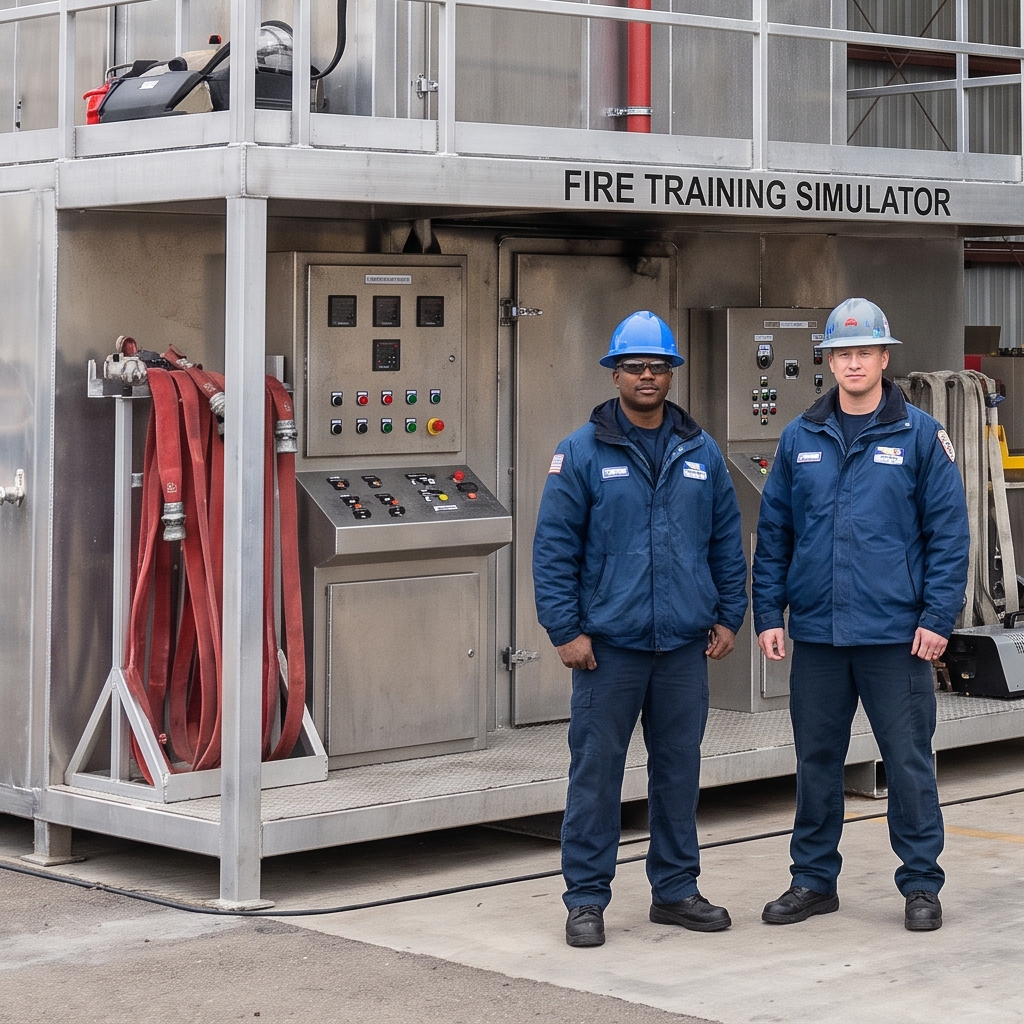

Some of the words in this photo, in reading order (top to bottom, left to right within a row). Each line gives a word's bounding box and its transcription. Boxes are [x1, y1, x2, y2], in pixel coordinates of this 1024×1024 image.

[564, 169, 635, 204] FIRE
[644, 173, 787, 210] TRAINING
[795, 181, 952, 217] SIMULATOR
